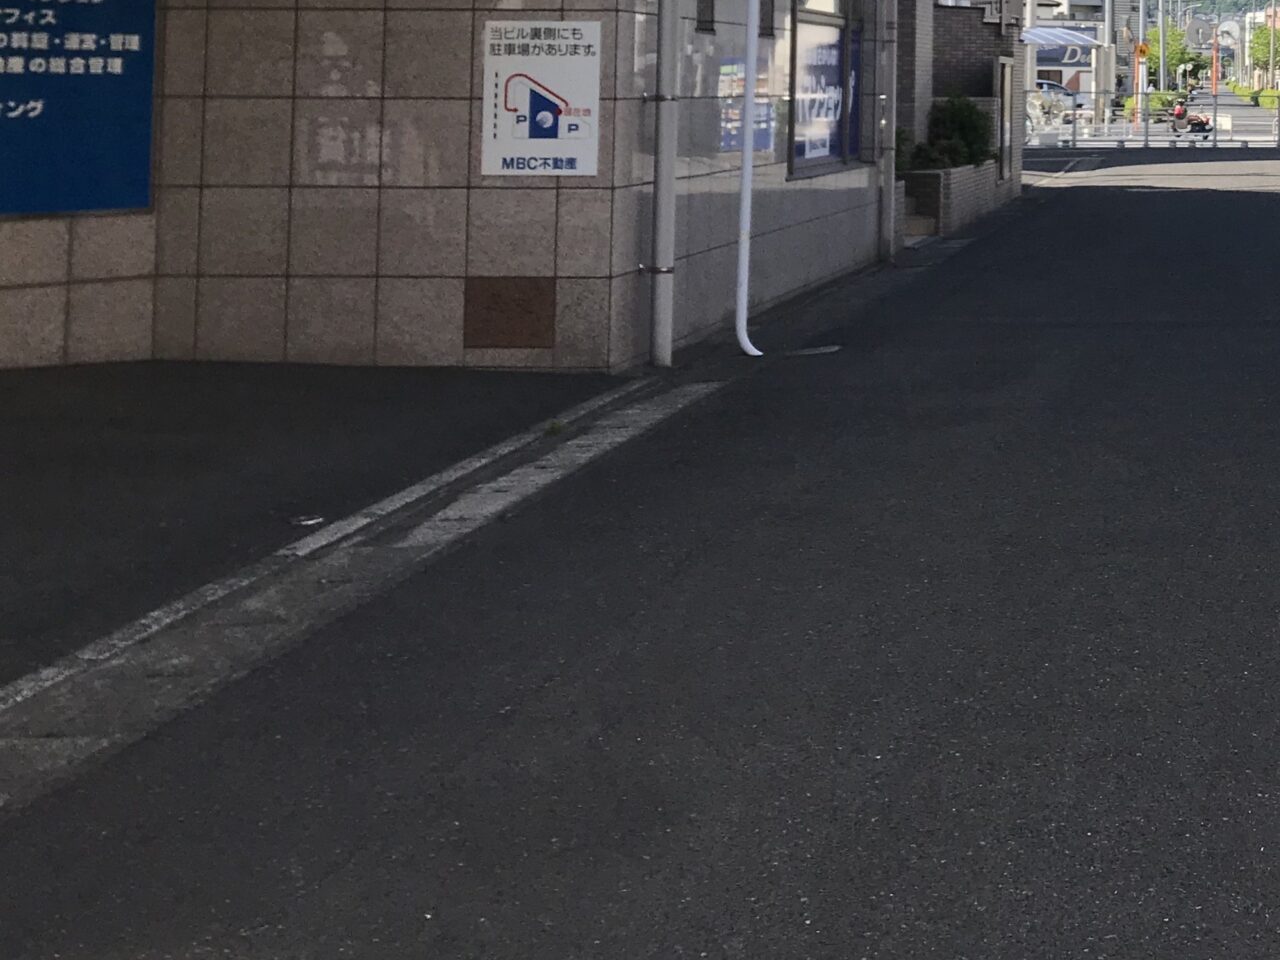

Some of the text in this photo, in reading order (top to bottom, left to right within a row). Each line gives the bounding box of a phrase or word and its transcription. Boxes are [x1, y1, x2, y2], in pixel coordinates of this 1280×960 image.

[0, 8, 56, 25] フィス
[490, 27, 583, 41] 当ビル裏側にも
[489, 43, 597, 57] 駐車場があります。
[516, 115, 527, 124] P
[567, 123, 579, 133] P
[501, 157, 577, 170] MBC不動産
